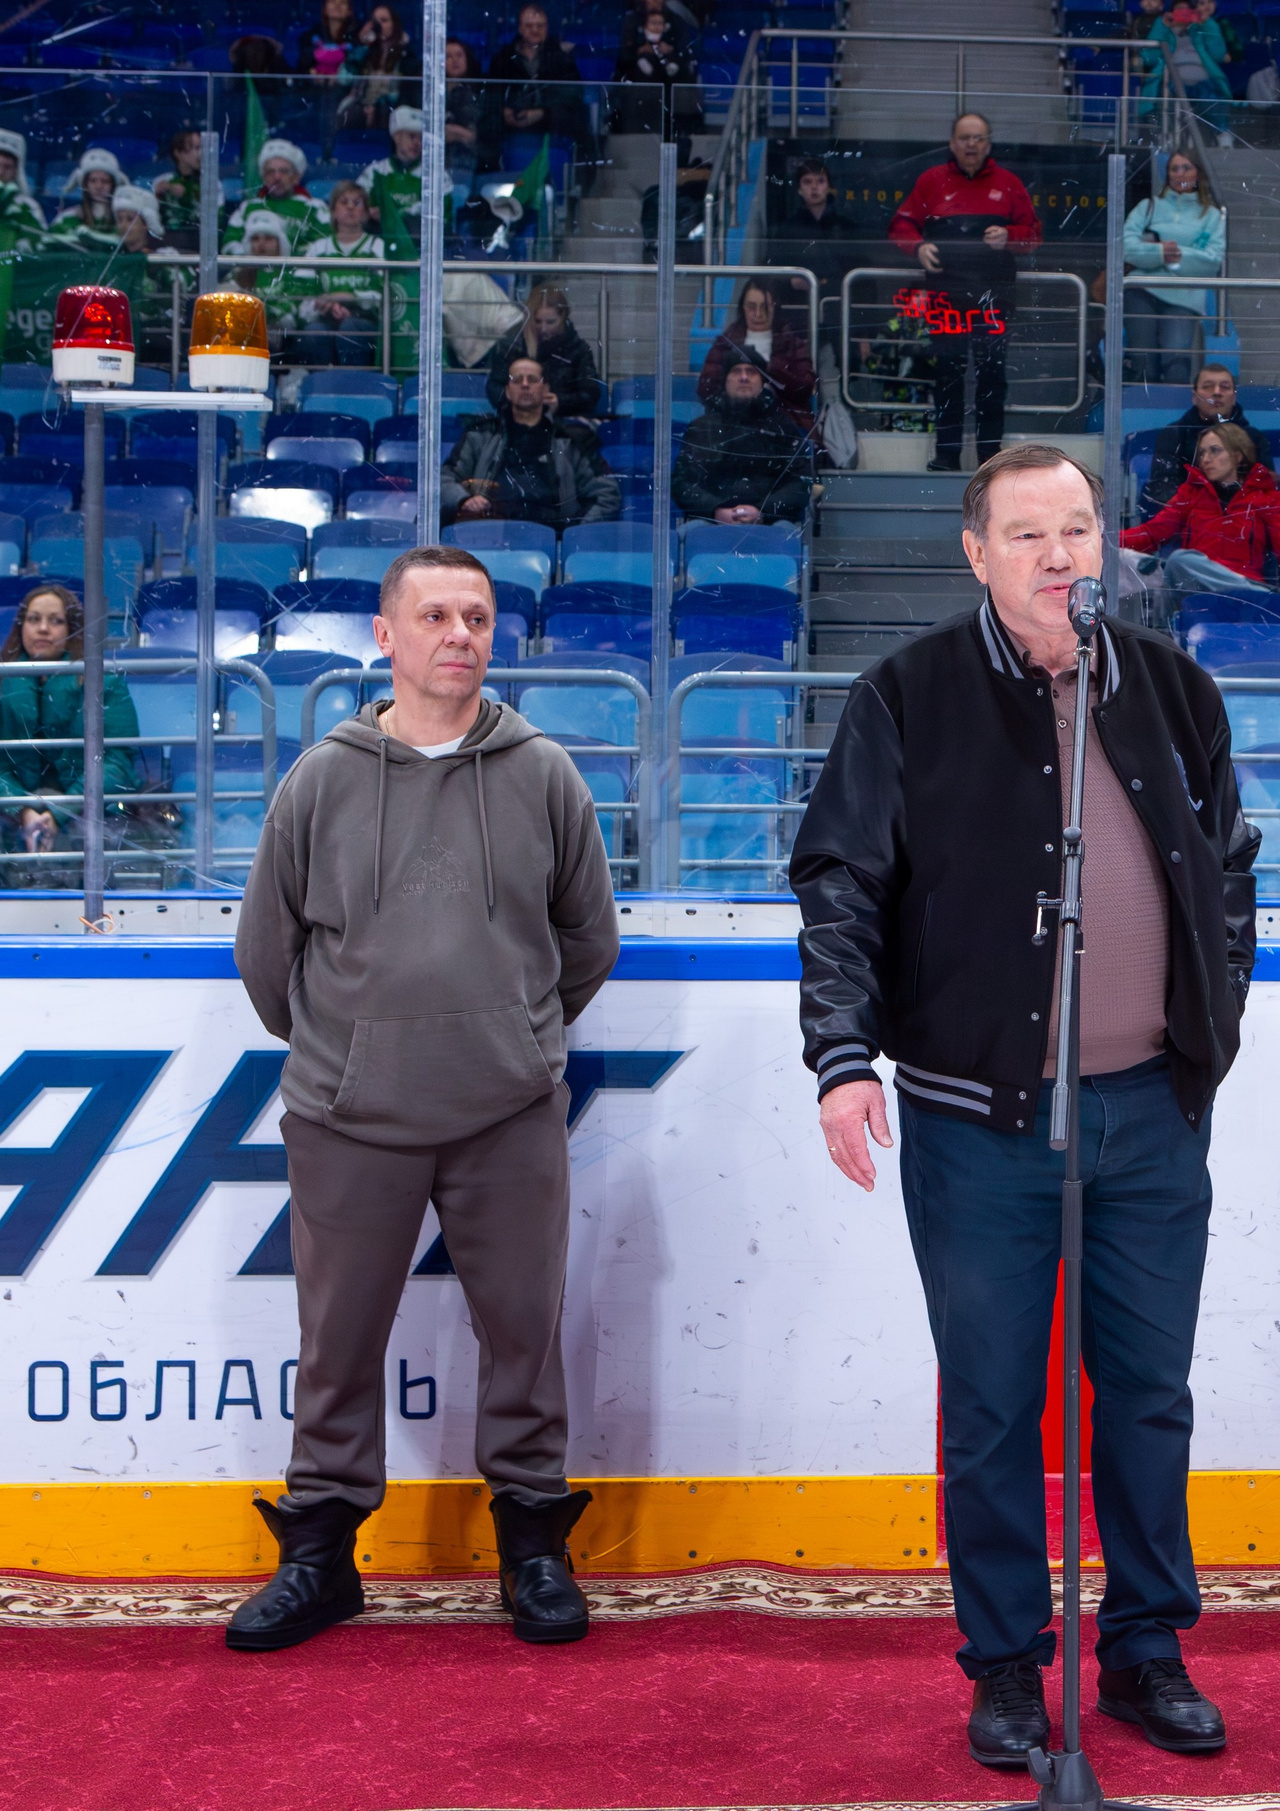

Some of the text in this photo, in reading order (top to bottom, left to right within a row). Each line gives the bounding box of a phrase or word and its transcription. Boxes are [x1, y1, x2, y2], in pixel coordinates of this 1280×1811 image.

[829, 188, 904, 203] КТОР
[1032, 194, 1106, 208] ECTOR
[27, 1359, 438, 1423] ОБЛАЬ
